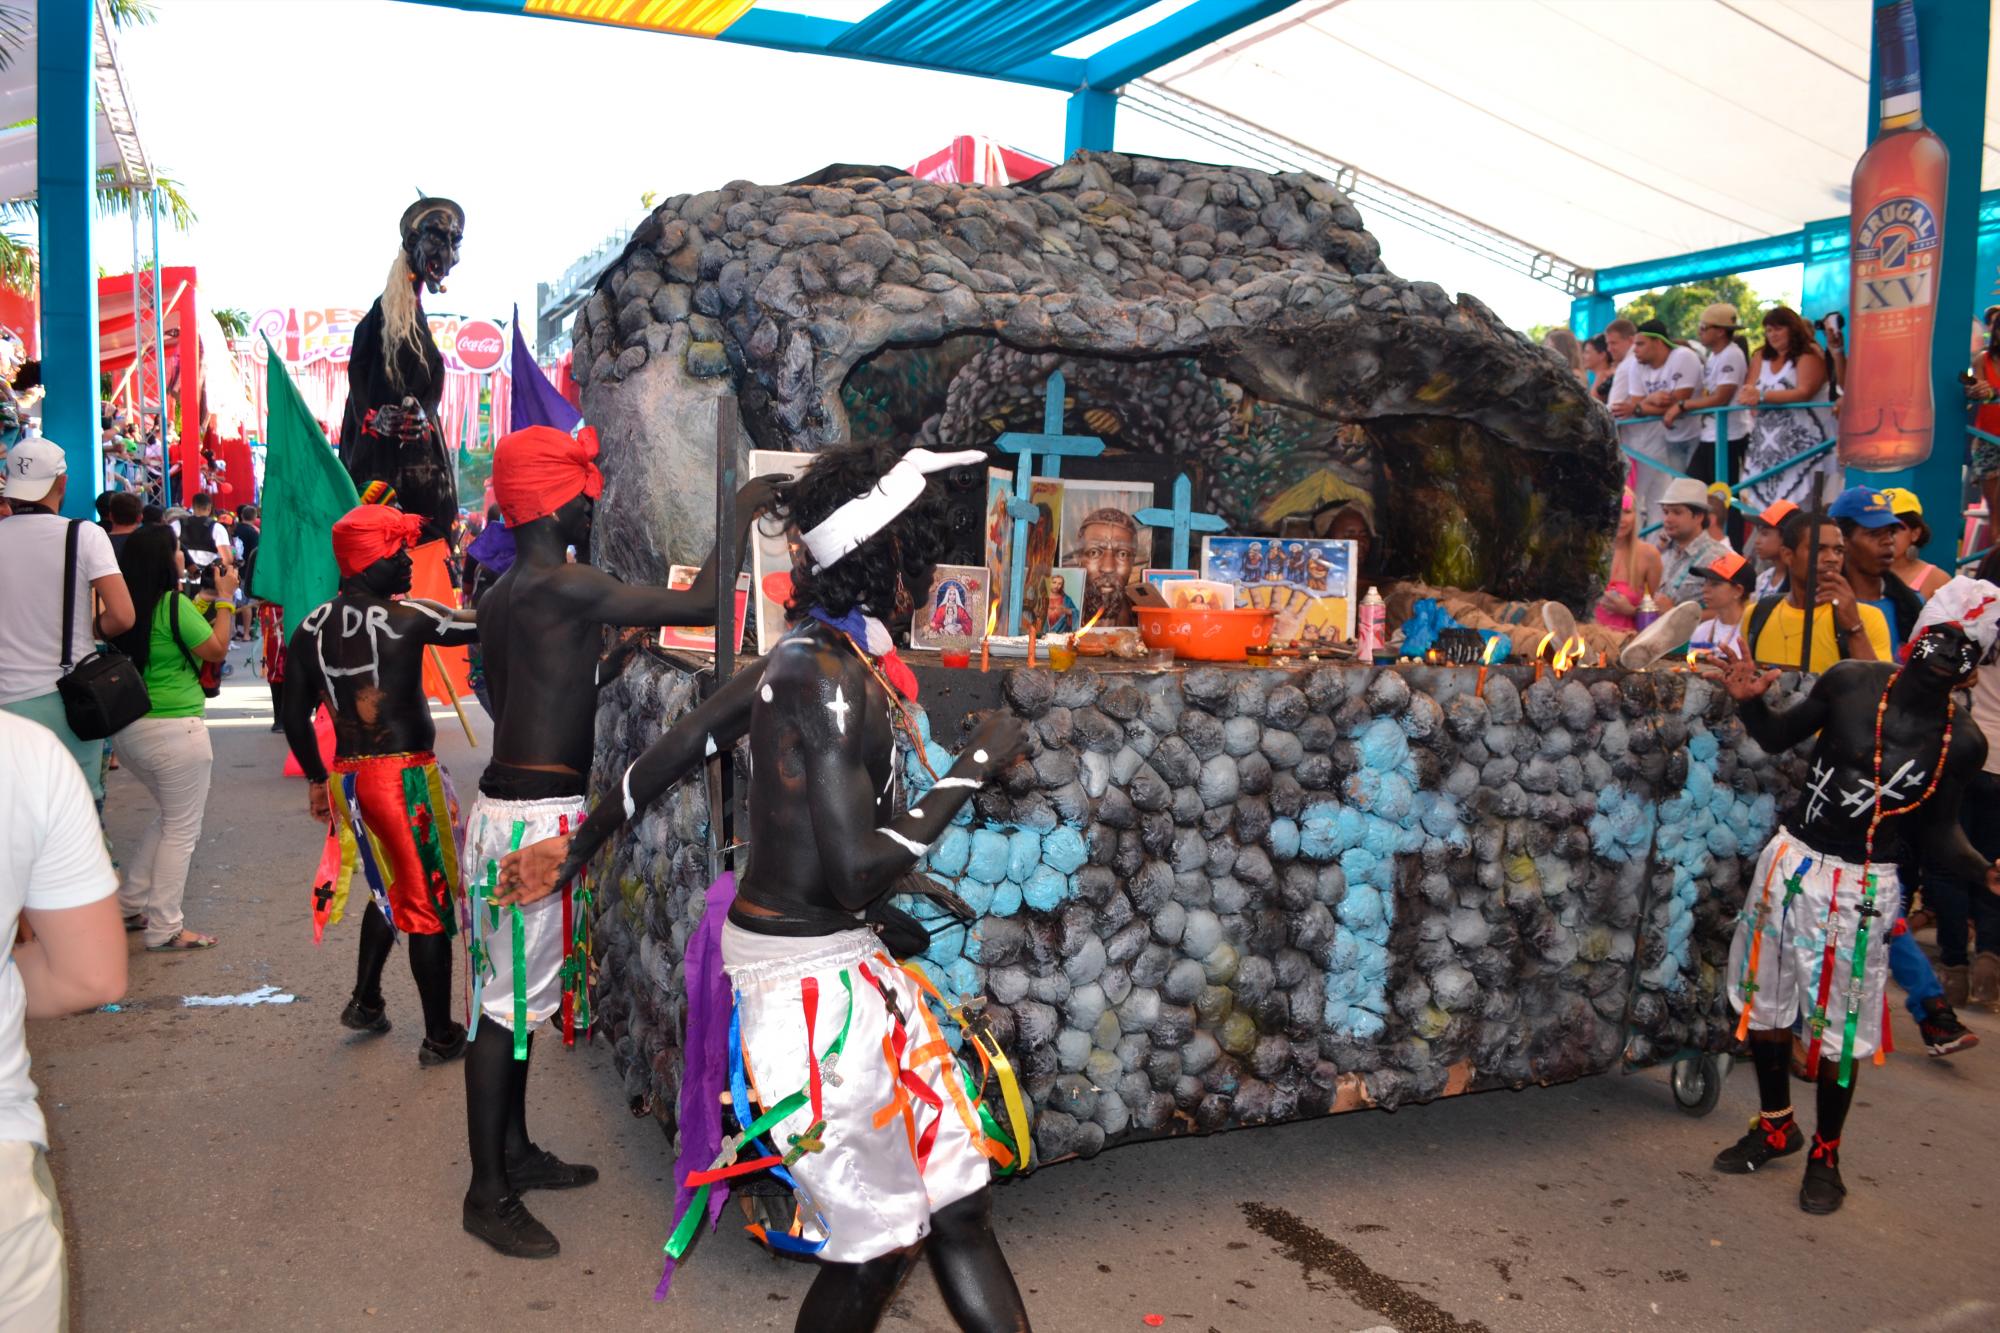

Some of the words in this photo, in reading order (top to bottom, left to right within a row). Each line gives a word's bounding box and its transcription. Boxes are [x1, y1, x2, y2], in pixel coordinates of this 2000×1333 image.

[1858, 202, 1933, 247] BRUGAL
[1862, 272, 1928, 310] XV
[341, 605, 404, 640] DR
